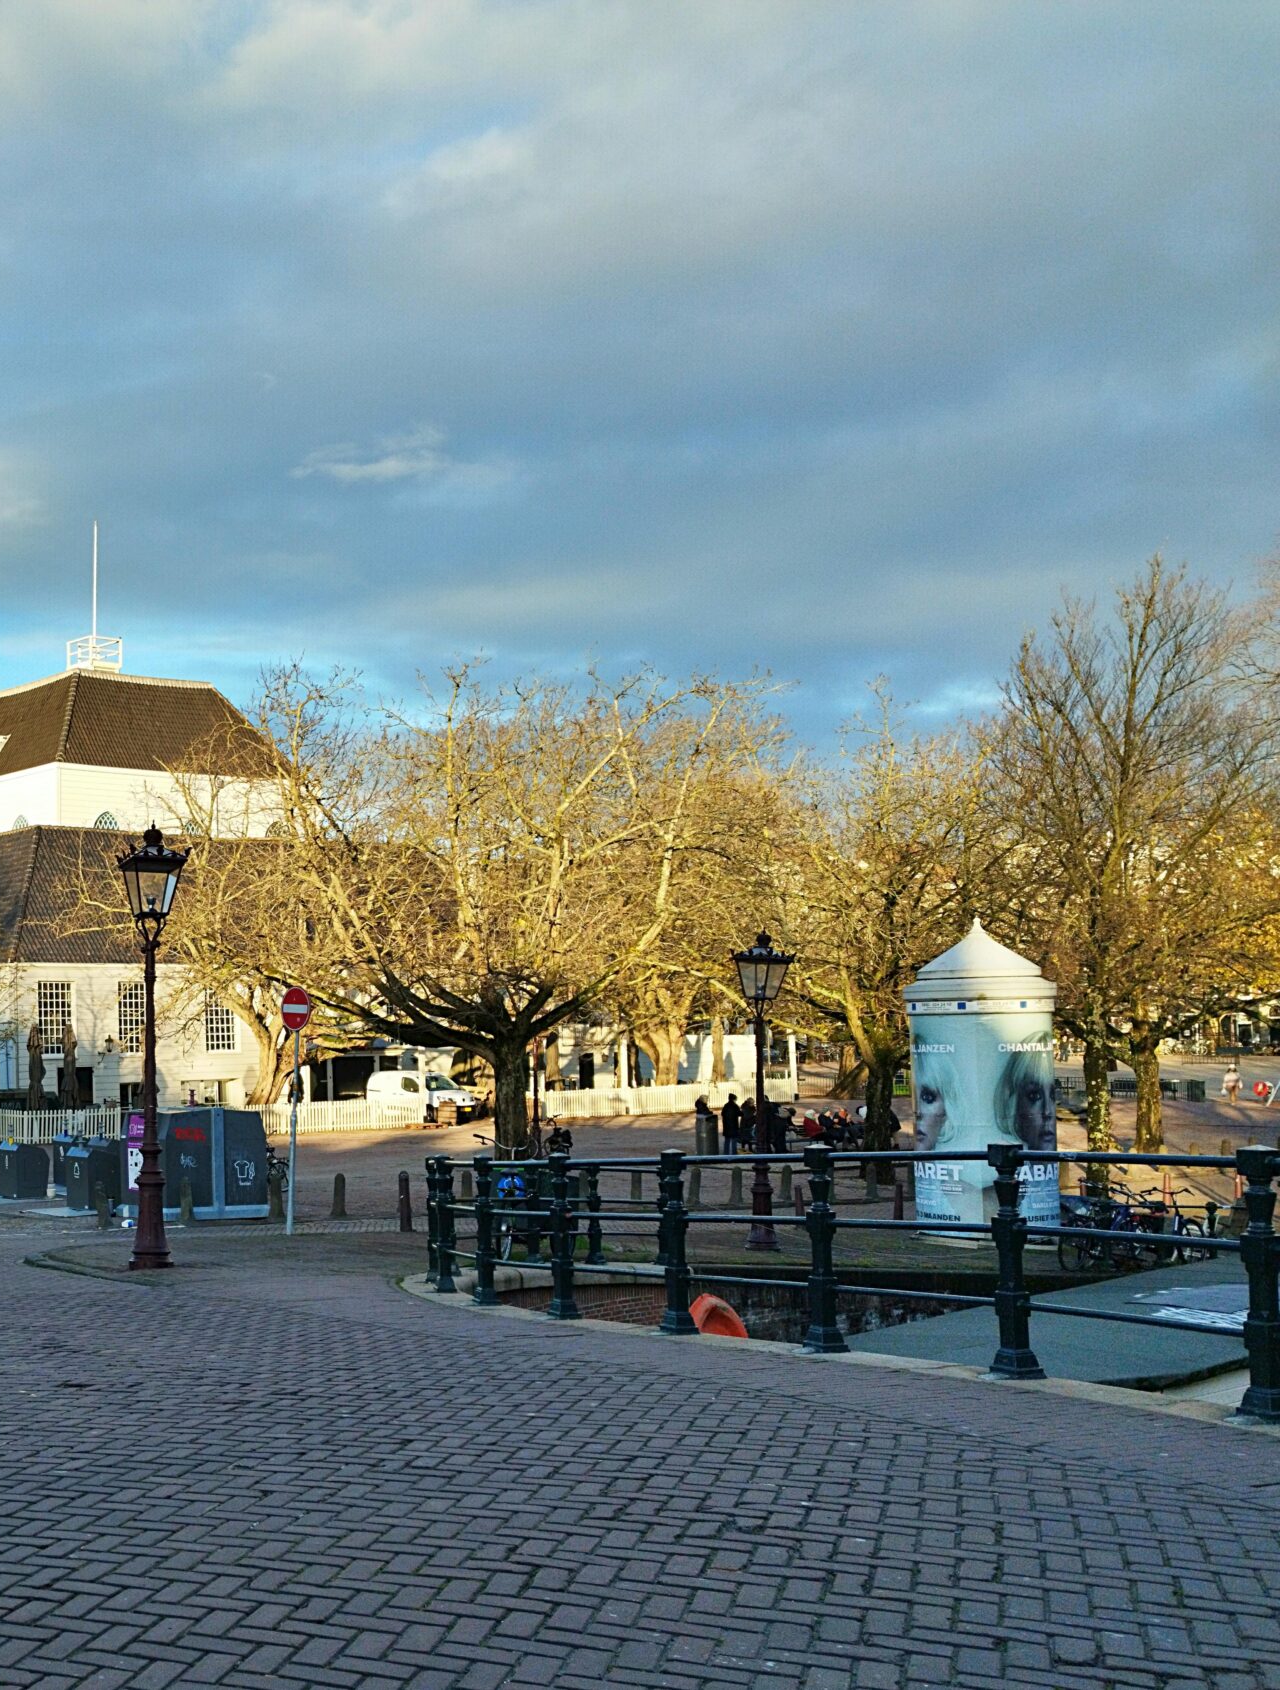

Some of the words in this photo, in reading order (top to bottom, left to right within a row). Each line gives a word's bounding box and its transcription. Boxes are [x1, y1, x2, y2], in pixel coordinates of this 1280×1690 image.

[918, 1044, 955, 1053] JANZEN
[998, 1042, 1046, 1052] CHANTAL
[924, 1212, 961, 1221] MAANDEN
